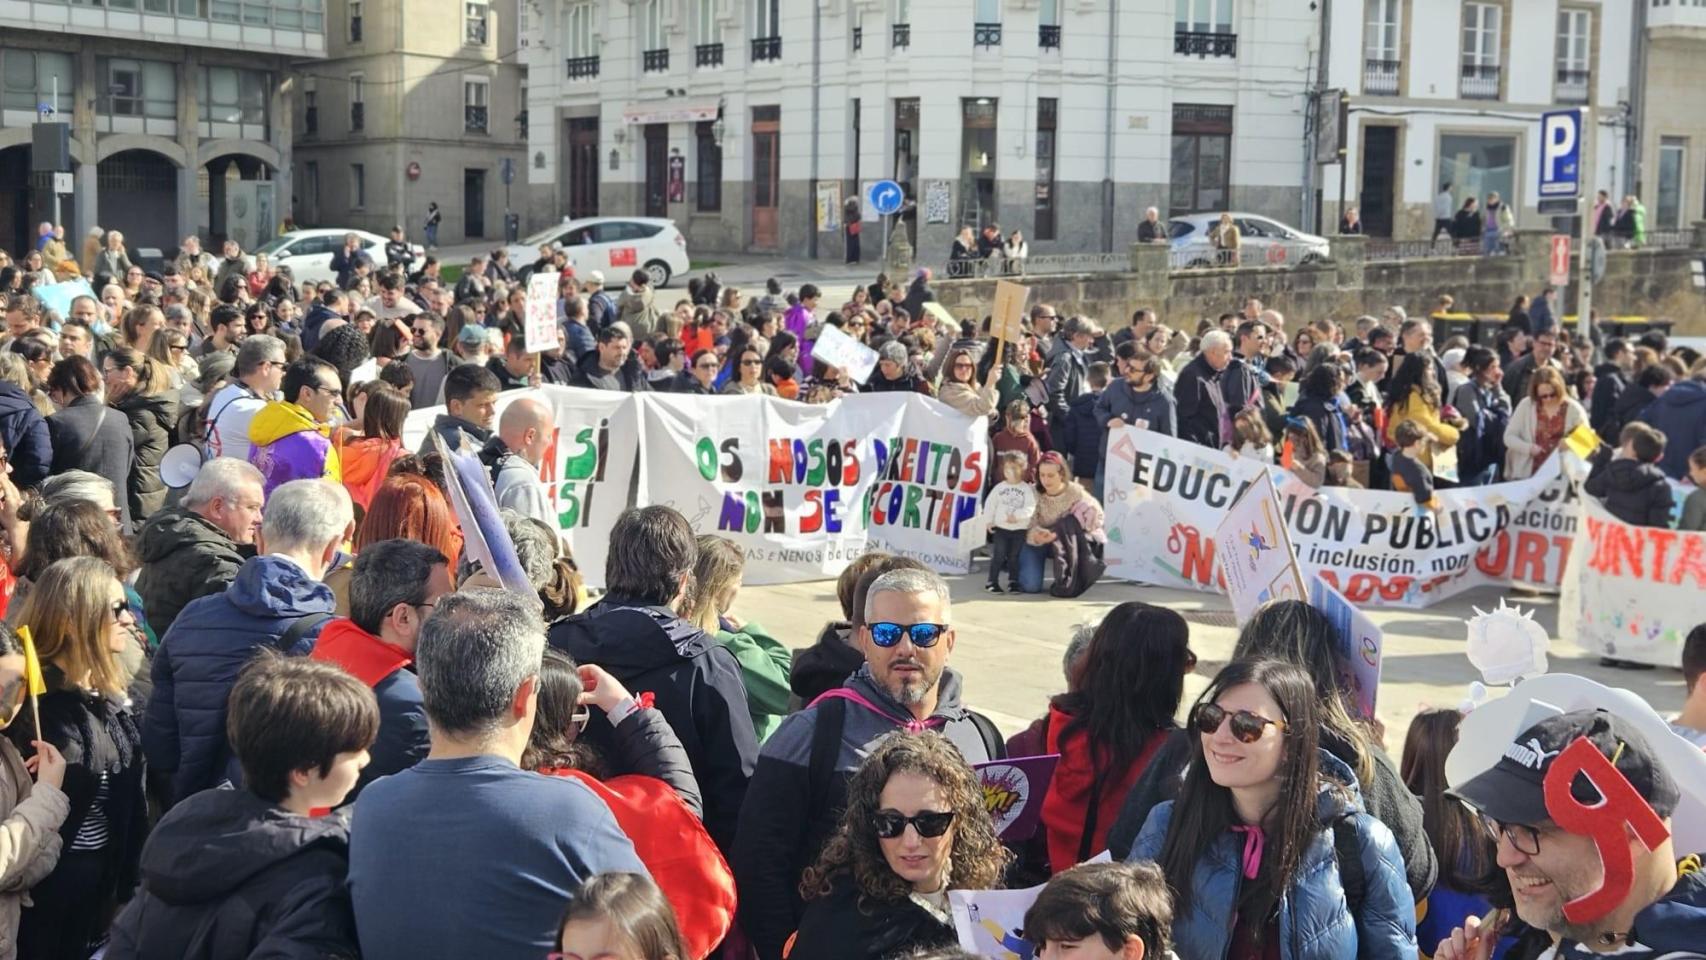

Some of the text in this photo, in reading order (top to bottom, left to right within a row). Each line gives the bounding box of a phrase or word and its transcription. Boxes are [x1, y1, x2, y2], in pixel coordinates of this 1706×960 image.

[1544, 115, 1575, 181] P
[695, 436, 743, 483] OS
[769, 438, 861, 487] NOSOS
[717, 489, 785, 534] NON
[799, 489, 842, 534] SE
